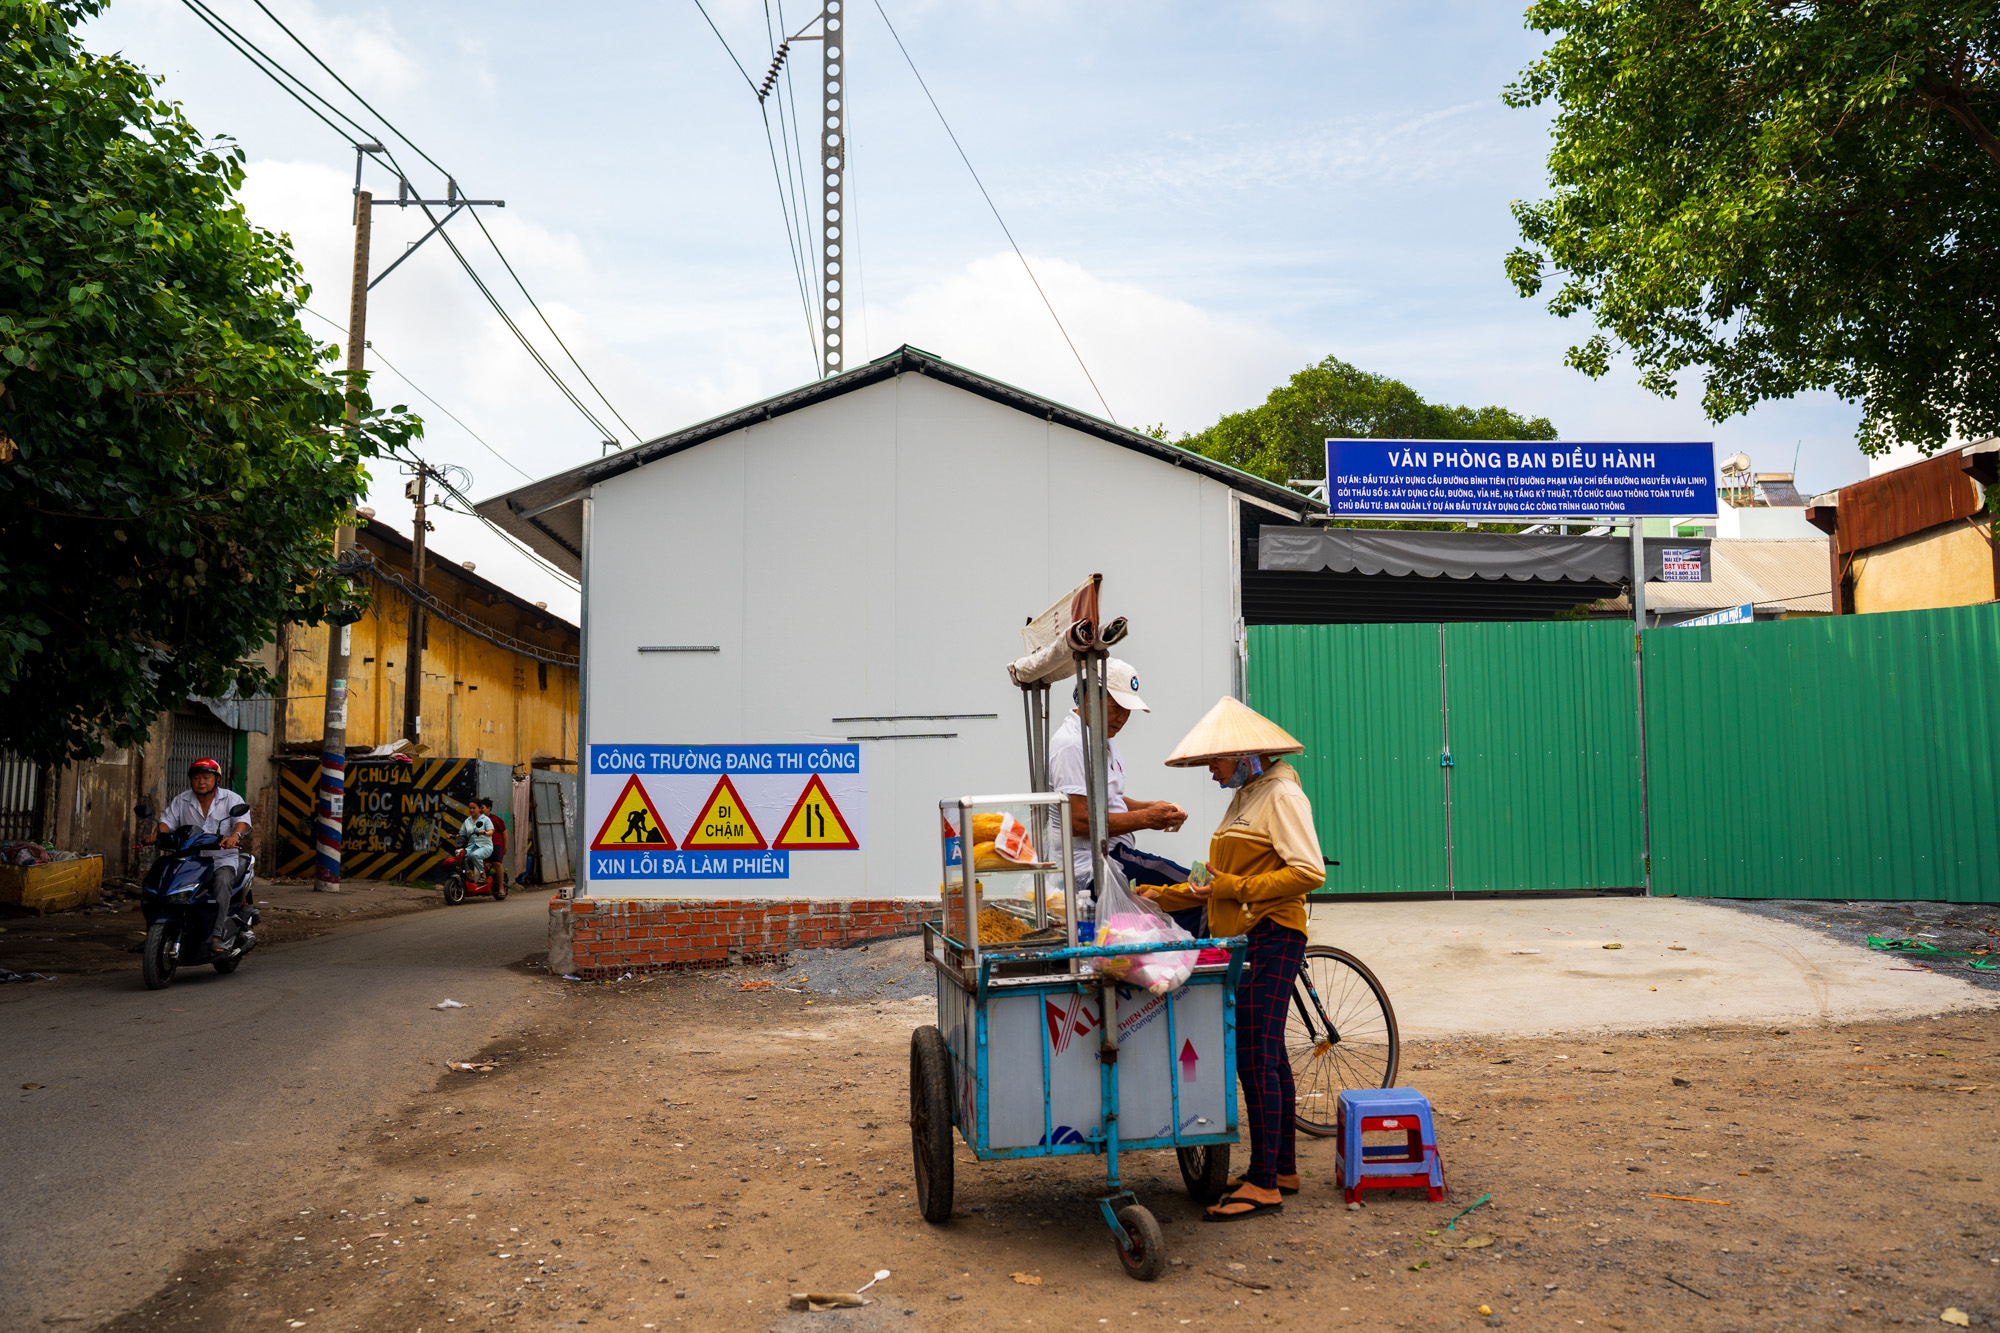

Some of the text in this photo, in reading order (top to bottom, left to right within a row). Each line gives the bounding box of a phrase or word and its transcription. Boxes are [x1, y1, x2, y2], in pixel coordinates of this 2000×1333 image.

[1388, 446, 1656, 468] VĂN PHÒNG BAN ĐIỀU HÀNH
[1338, 475, 1348, 485] DỰ
[1348, 474, 1362, 484] ÁN:
[1379, 476, 1389, 484] TƯ
[1390, 474, 1404, 484] XÂY
[1406, 475, 1426, 486] DỰNG
[1444, 474, 1469, 484] ĐƯỜNG
[1470, 475, 1488, 484] BÌNH
[1489, 476, 1505, 485] TIÊN
[1507, 476, 1519, 486] (TỪ
[1520, 475, 1545, 485] ĐƯỜNG
[1547, 477, 1567, 486] PHẠM
[1568, 476, 1583, 485] VĂN
[1584, 475, 1597, 485] CHÍ
[1598, 474, 1612, 485] ĐẾN
[1614, 476, 1639, 485] ĐƯỜNG
[1641, 474, 1670, 485] NGUYỄN
[1672, 475, 1686, 485] VĂN
[1688, 477, 1707, 486] LINH)
[1338, 487, 1351, 497] GÓI
[1372, 486, 1383, 497] SỐ
[1384, 489, 1390, 497] 6:
[1392, 487, 1406, 497] XÂY
[1408, 488, 1428, 498] DỰNG
[1448, 488, 1476, 498] ĐƯỜNG,
[1490, 488, 1502, 499] HÈ,
[1504, 490, 1514, 499] HẠ
[1536, 489, 1545, 497] KỸ
[1547, 488, 1572, 499] THUẬT,
[1573, 486, 1583, 497] TỔ
[1584, 488, 1604, 497] CHỨC
[1624, 488, 1649, 497] THÔNG
[1650, 488, 1670, 497] TOÀN
[1671, 487, 1694, 497] TUYẾN
[1338, 499, 1353, 509] CHỦ
[1371, 501, 1383, 509] TƯ:
[1400, 500, 1420, 510] QUẢN
[1422, 501, 1431, 510] LÝ
[1433, 502, 1444, 511] DỰ
[1444, 501, 1454, 510] ÁN
[1472, 502, 1482, 510] TƯ
[1483, 501, 1497, 510] XÂY
[1498, 502, 1519, 512] DỰNG
[1520, 501, 1535, 510] CÁC
[1536, 501, 1557, 510] CÔNG
[1558, 501, 1580, 510] TRÌNH
[1600, 501, 1625, 510] THÔNG
[598, 749, 856, 769] CÔNG TRƯỜNG ĐANG THI CÔNG
[358, 788, 392, 812] TÓC
[402, 793, 439, 813] NAM
[718, 806, 731, 818] ĐI
[706, 821, 744, 840] CHẬM
[597, 851, 784, 874] XIN LỖI ĐÃ LÀM PHIỀN
[1172, 985, 1190, 1001] anel
